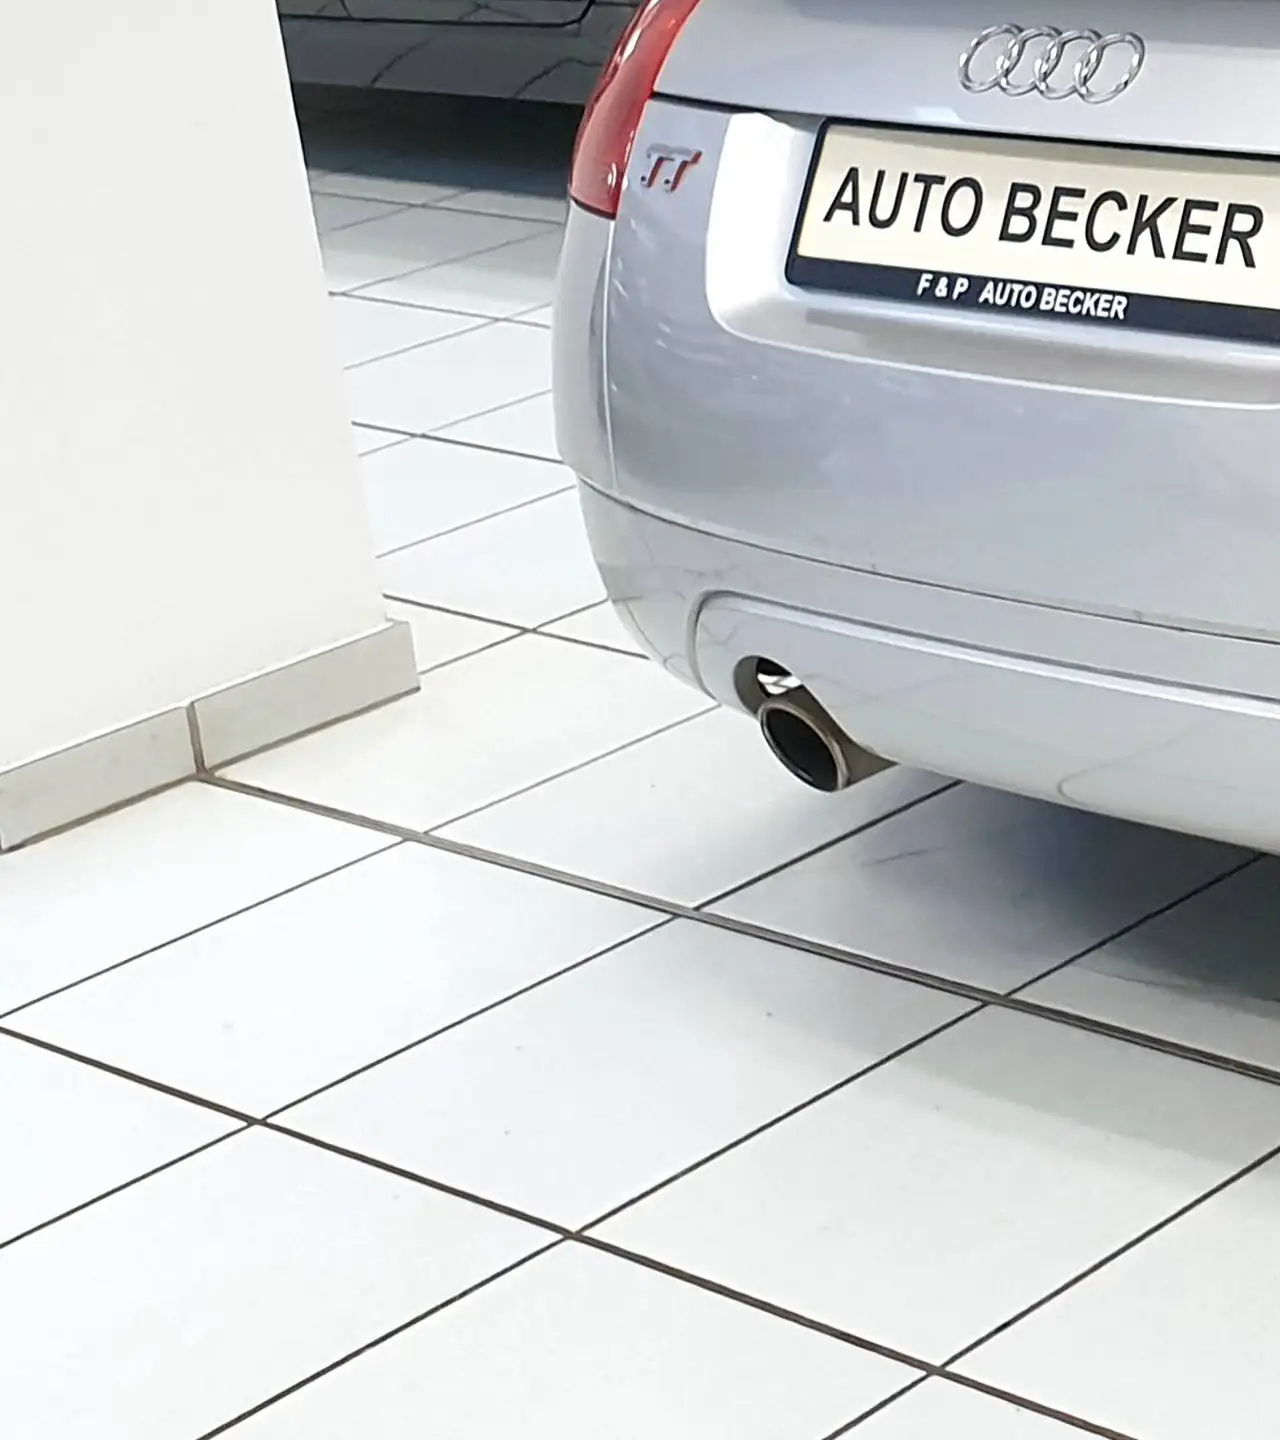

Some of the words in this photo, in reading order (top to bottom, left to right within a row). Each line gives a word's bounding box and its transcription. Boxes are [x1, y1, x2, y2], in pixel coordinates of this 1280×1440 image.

[824, 166, 983, 238] AUTO
[999, 182, 1265, 269] BECKER
[916, 273, 933, 297] F
[935, 277, 949, 300] &
[953, 279, 969, 302] P
[979, 281, 1038, 310] AUTO
[1039, 286, 1128, 320] BECKER
